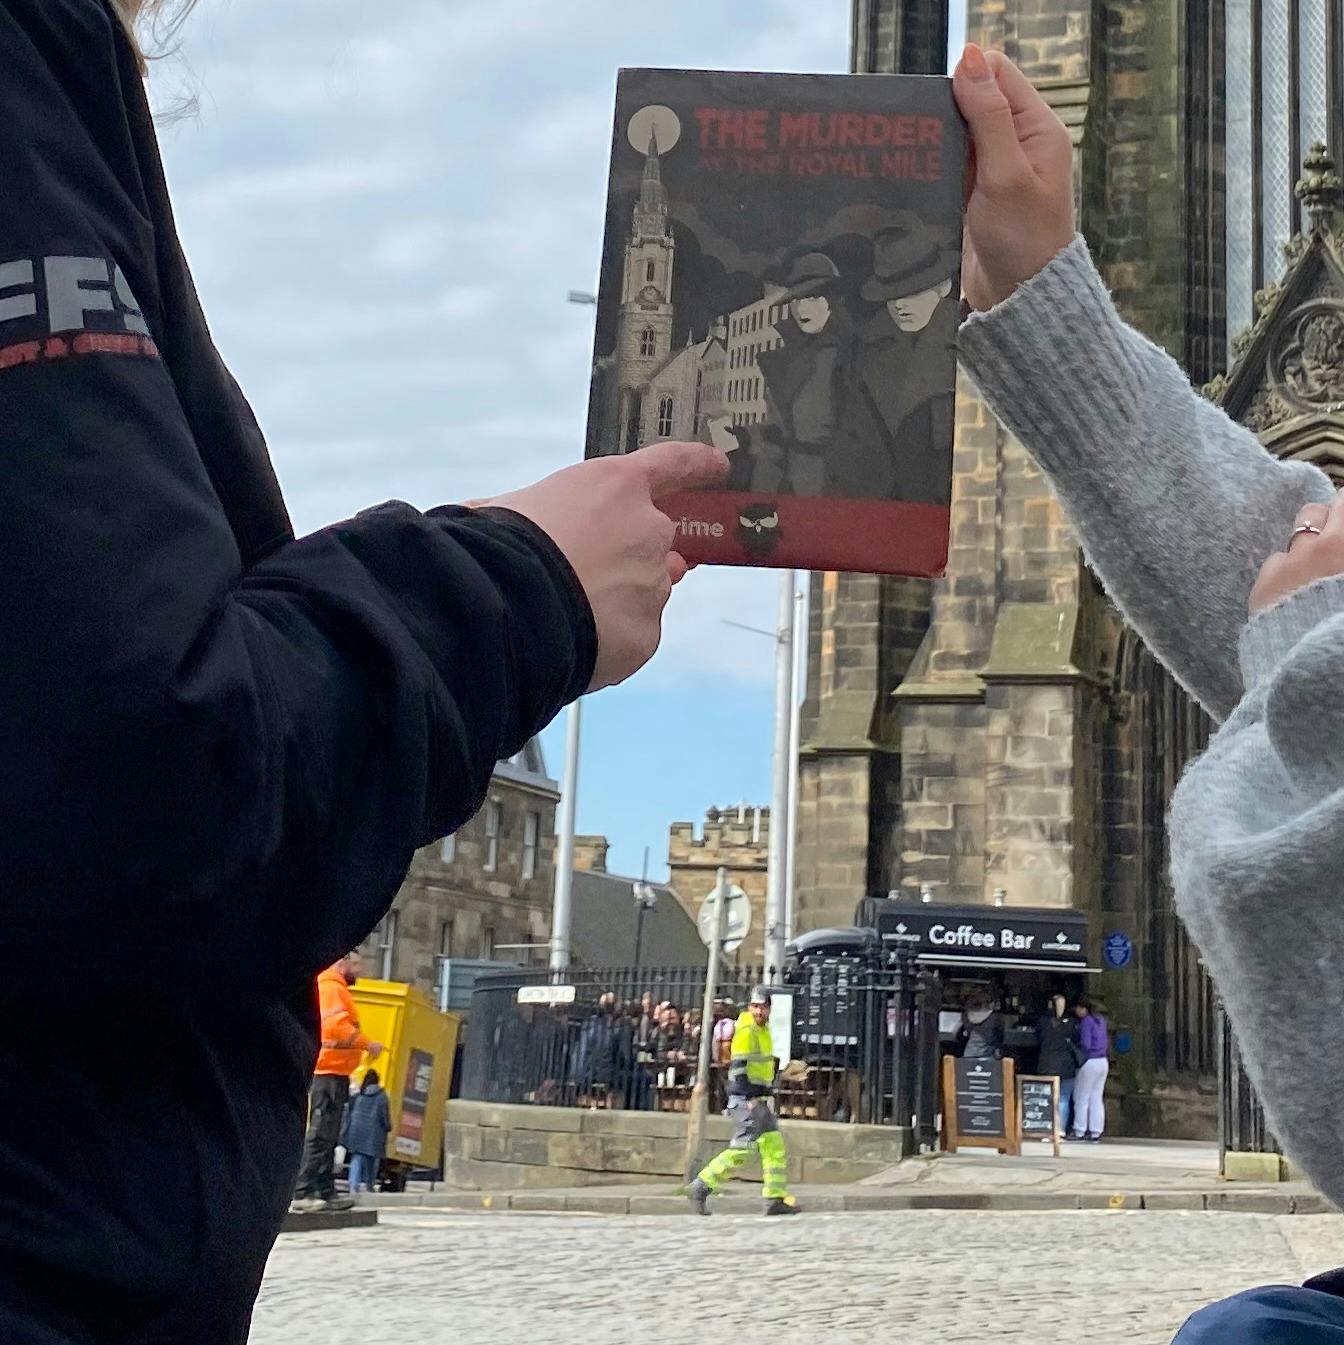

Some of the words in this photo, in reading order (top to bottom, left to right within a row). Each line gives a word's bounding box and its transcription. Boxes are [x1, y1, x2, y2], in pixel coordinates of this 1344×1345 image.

[695, 108, 769, 149] THE
[778, 111, 944, 149] MURDER
[788, 150, 873, 177] ROYAL
[880, 150, 944, 181] MILE
[928, 924, 996, 947] Coffee
[1000, 928, 1035, 950] Bar
